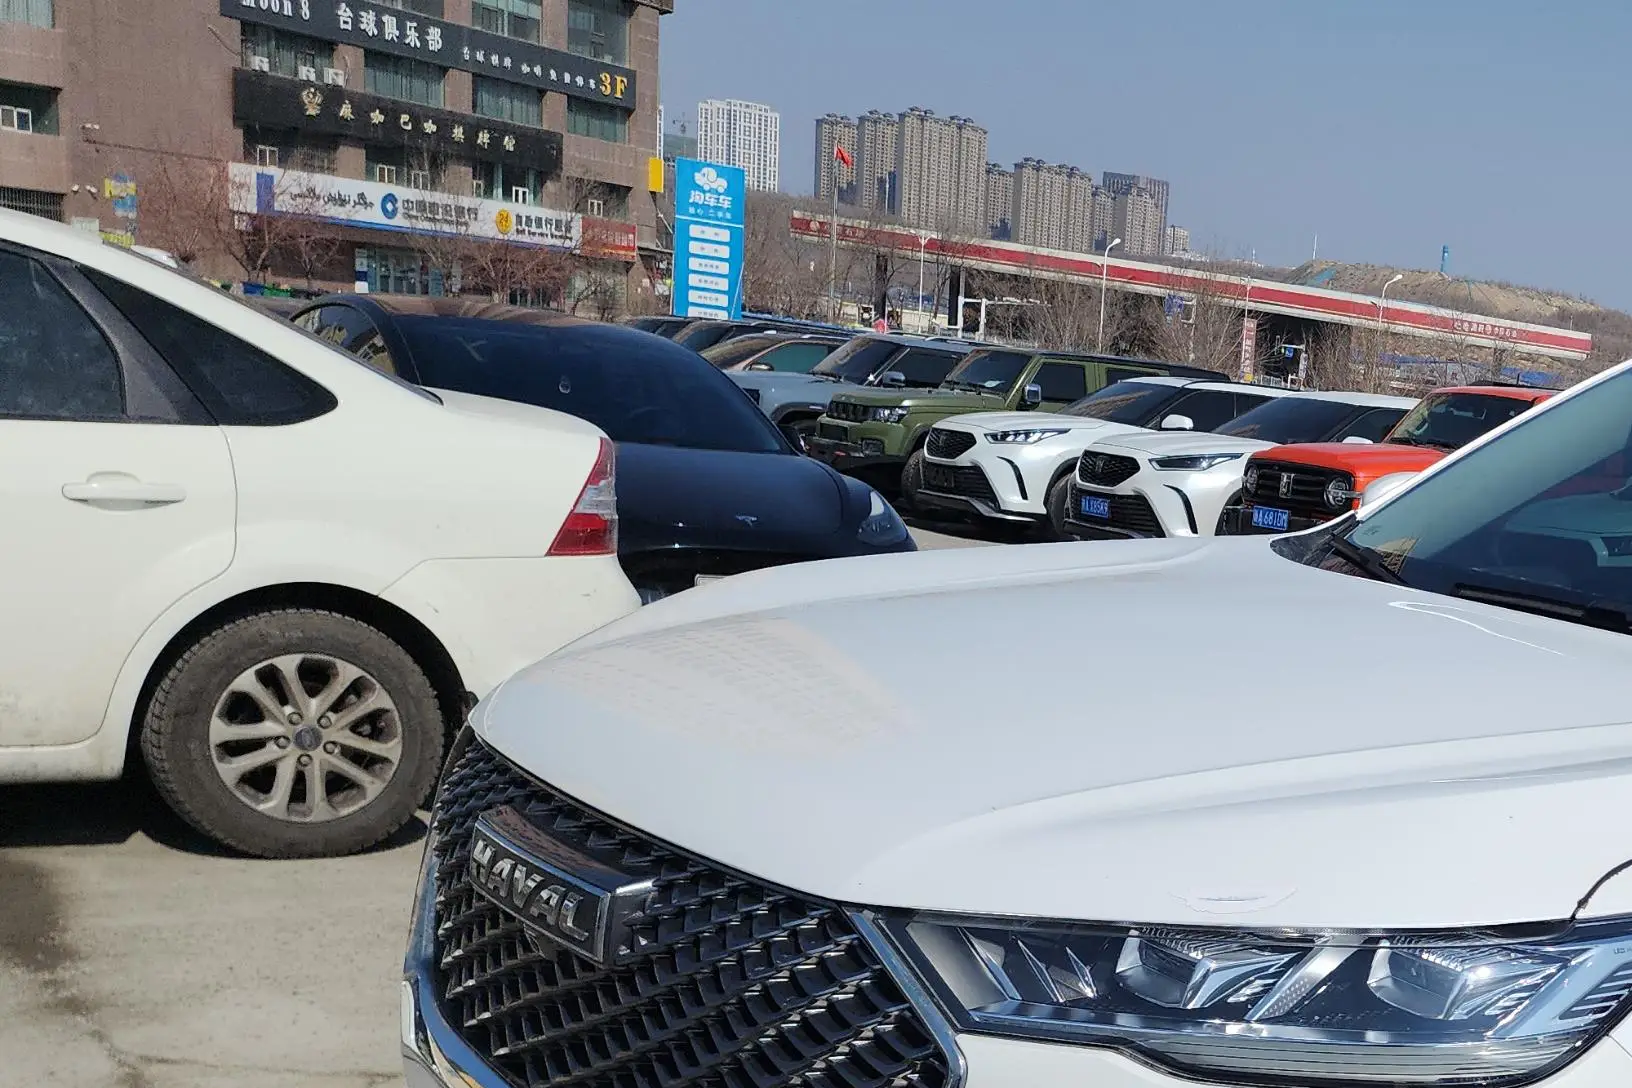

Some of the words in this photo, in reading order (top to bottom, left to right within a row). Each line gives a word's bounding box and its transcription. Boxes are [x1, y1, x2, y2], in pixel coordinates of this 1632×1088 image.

[335, 2, 443, 52] 台球俱乐部
[600, 71, 628, 99] 3F
[472, 839, 589, 941] HAVAL
